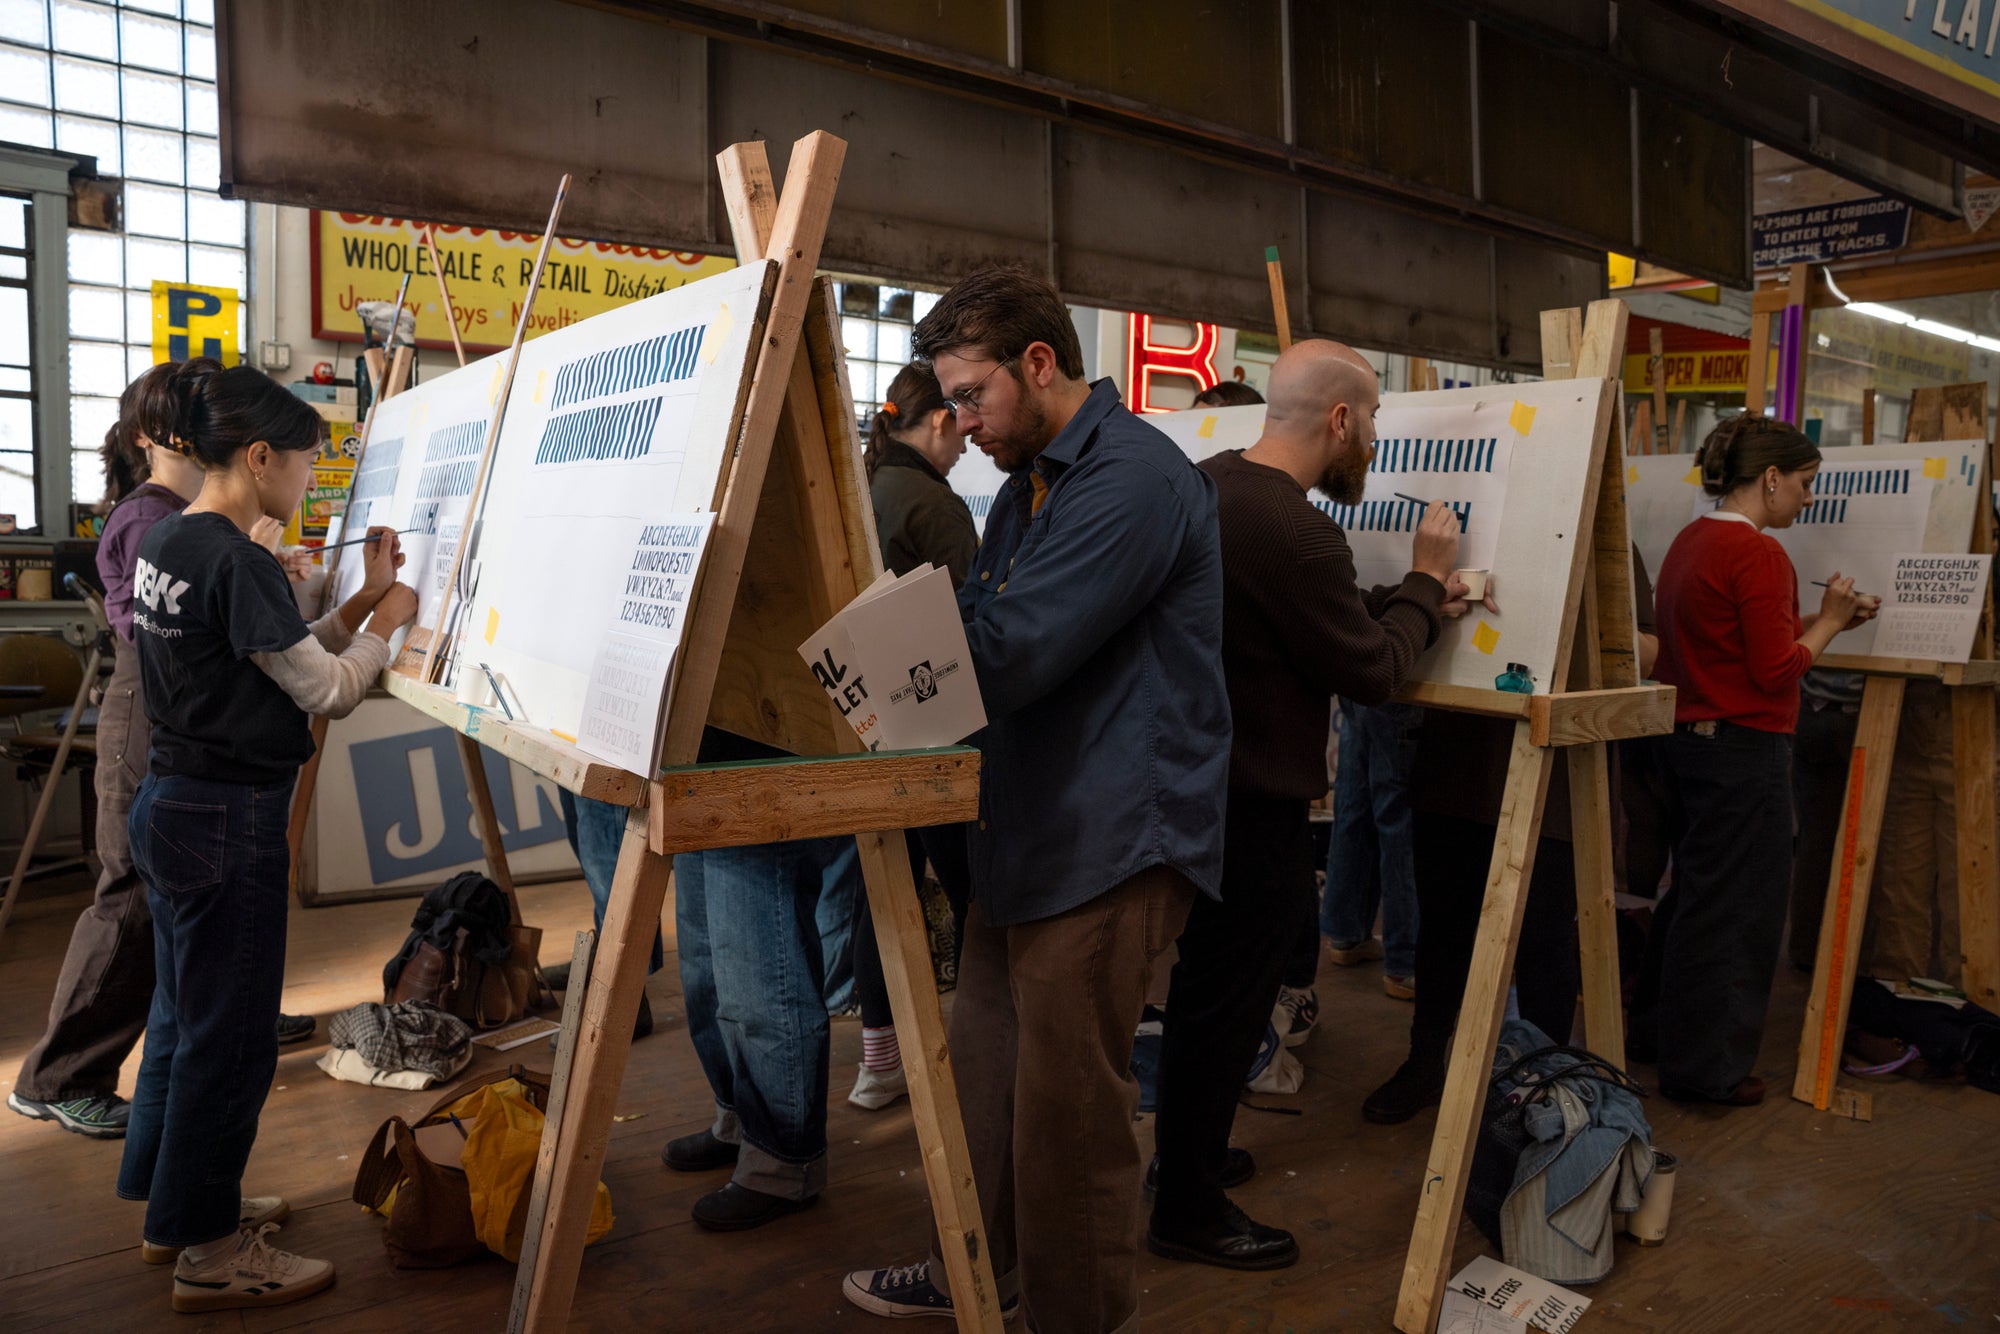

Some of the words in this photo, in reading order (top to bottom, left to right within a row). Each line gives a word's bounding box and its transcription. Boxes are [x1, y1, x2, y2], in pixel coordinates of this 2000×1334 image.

[1805, 208, 1829, 224] ARE
[1763, 233, 1779, 245] TO
[1781, 227, 1820, 242] ENTER
[1822, 221, 1860, 237] UPON
[1752, 247, 1795, 262] CROSS
[520, 258, 591, 294] RTAIL
[1897, 559, 1981, 570] ABCDEFGHIJK
[1896, 570, 1979, 581] LMNOPQRSTU
[1897, 593, 1969, 605] 1234567890
[1487, 1277, 1523, 1311] LETTERS
